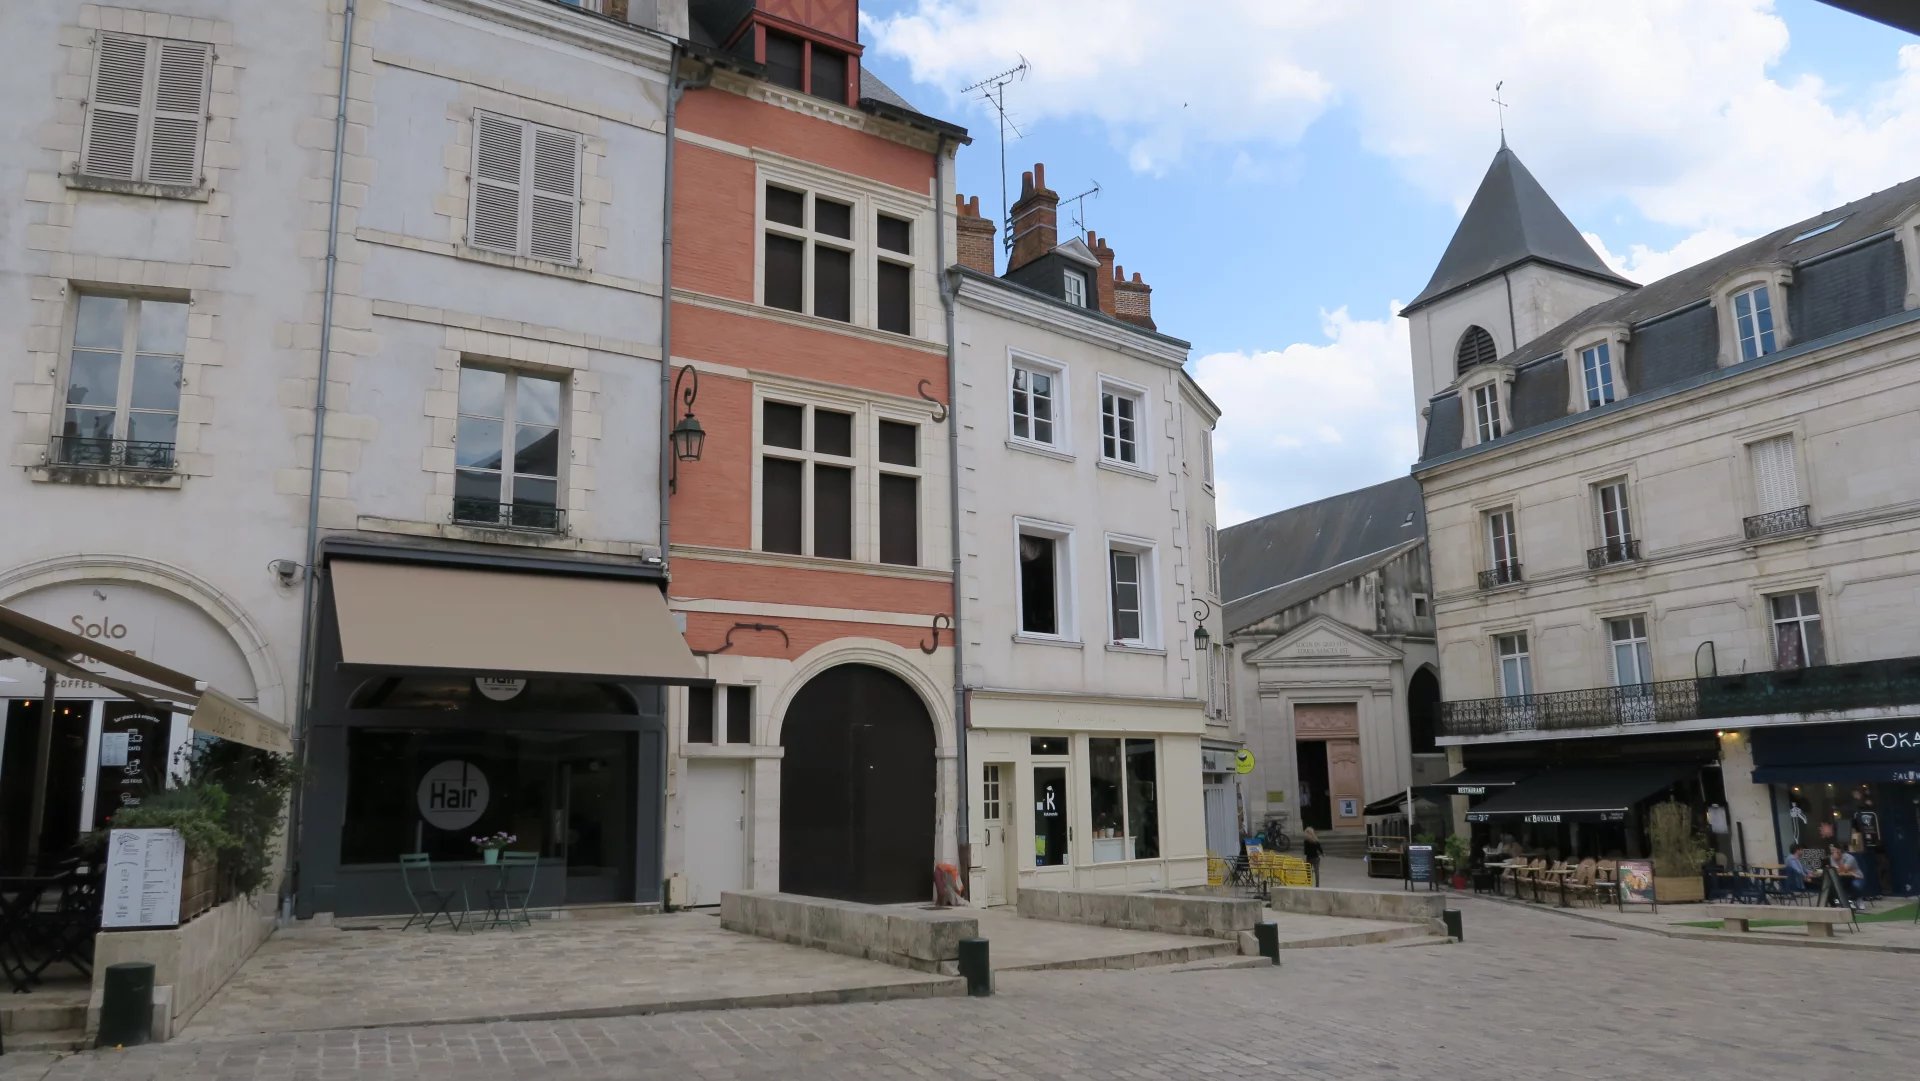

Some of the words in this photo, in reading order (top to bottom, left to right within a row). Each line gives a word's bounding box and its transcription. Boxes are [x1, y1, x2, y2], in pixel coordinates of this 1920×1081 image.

[71, 614, 128, 639] Solo
[430, 782, 477, 809] Hair
[1458, 786, 1485, 795] RESTAURANT
[1532, 814, 1561, 823] BOUILLON
